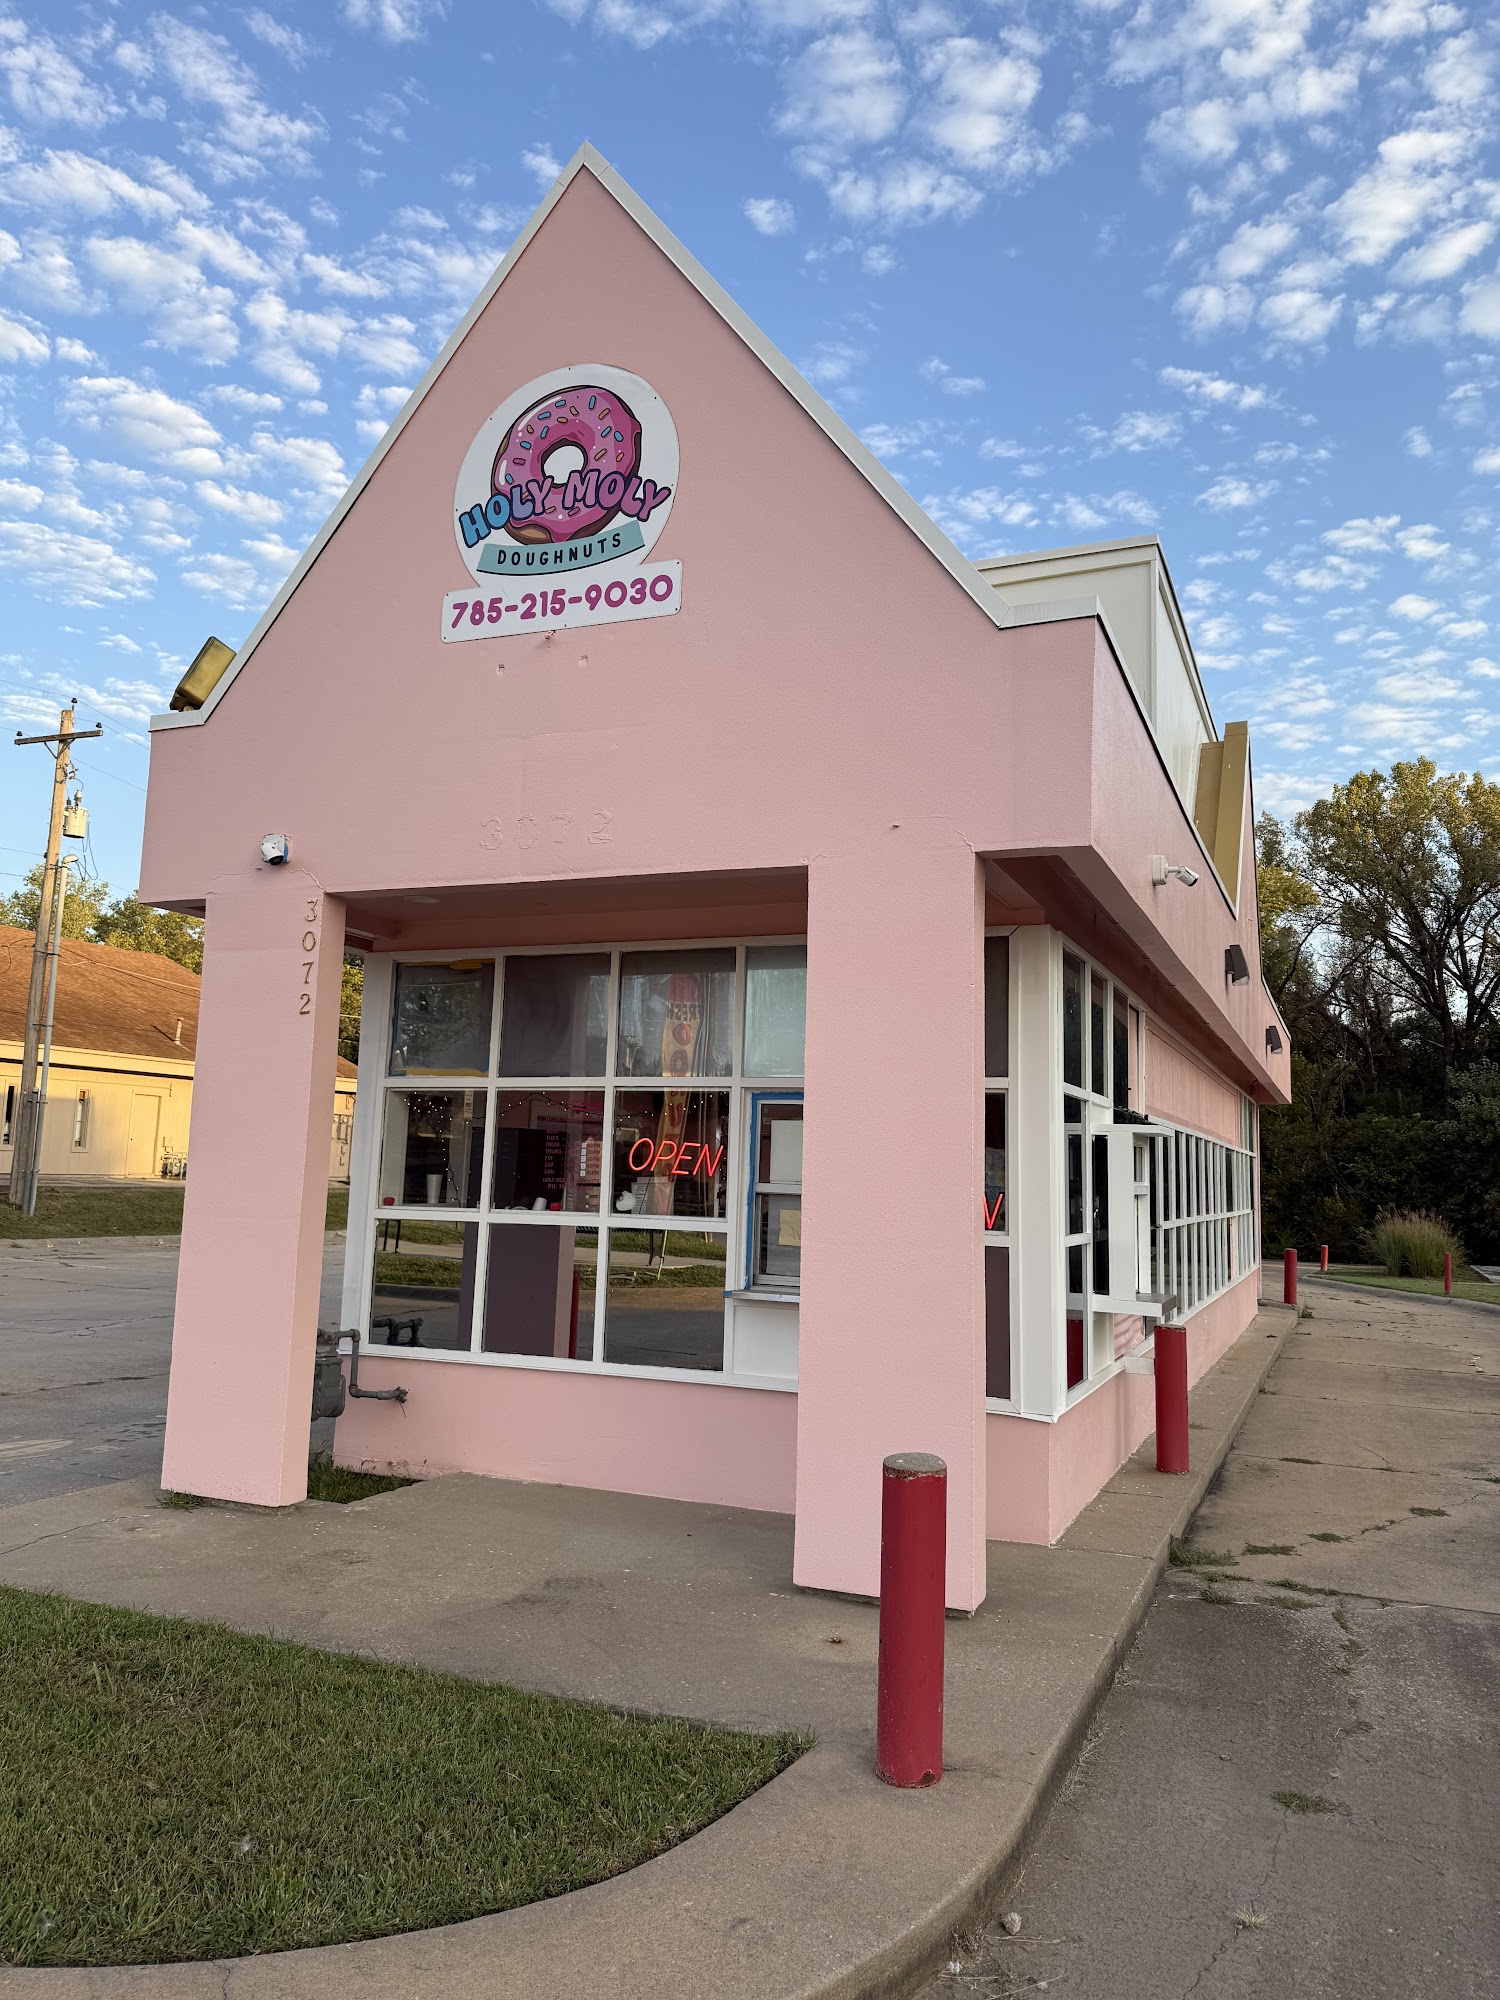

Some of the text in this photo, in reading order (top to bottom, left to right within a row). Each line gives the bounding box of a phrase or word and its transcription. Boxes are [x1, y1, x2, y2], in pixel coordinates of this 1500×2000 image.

[459, 469, 671, 548] HOLY MOLY
[497, 532, 621, 566] DOUGHNUTS
[451, 574, 674, 629] 785-215-9030
[299, 898, 319, 1015] 3072
[628, 1137, 724, 1177] OPEN
